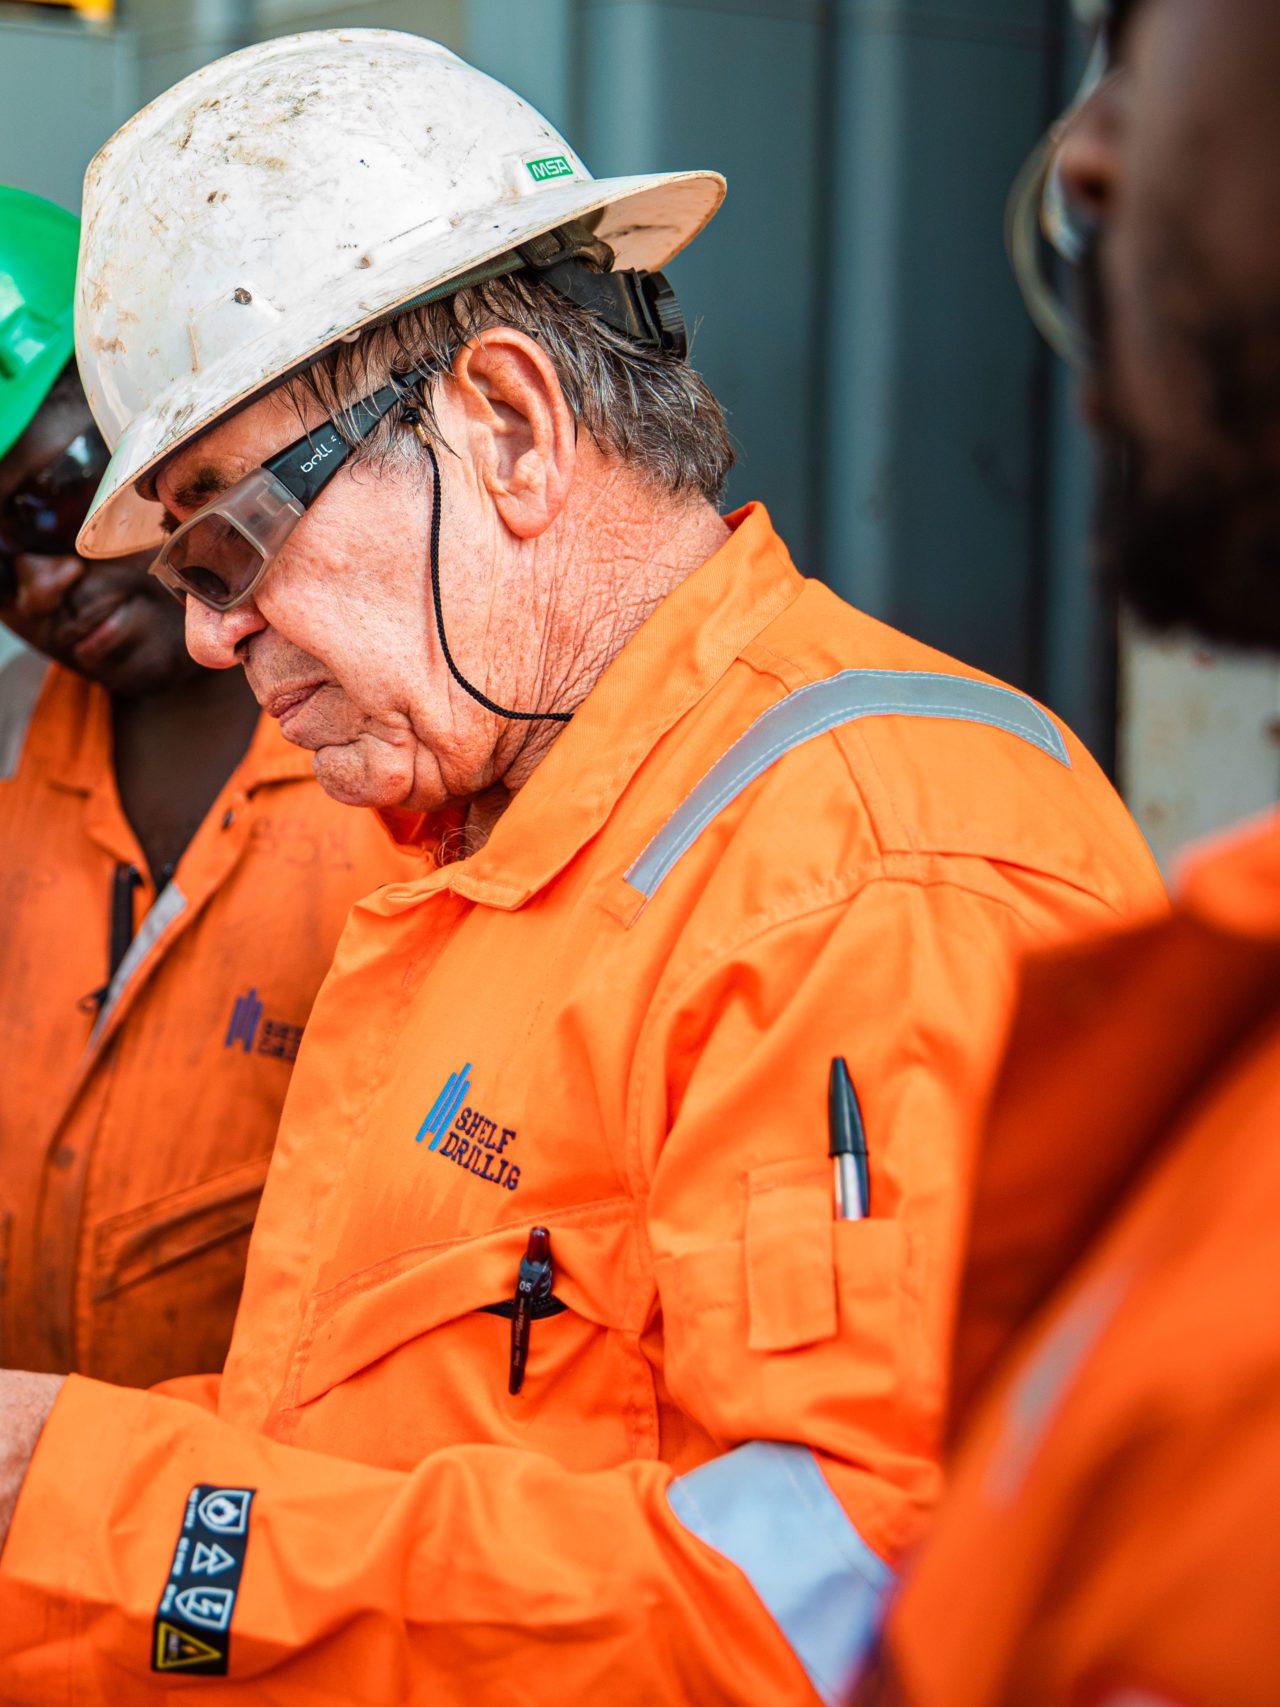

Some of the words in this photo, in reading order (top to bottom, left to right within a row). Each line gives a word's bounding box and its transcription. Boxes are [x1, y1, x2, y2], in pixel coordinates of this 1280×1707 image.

[531, 158, 571, 179] MSA
[454, 1106, 517, 1154] SHELF
[519, 1281, 532, 1293] 05
